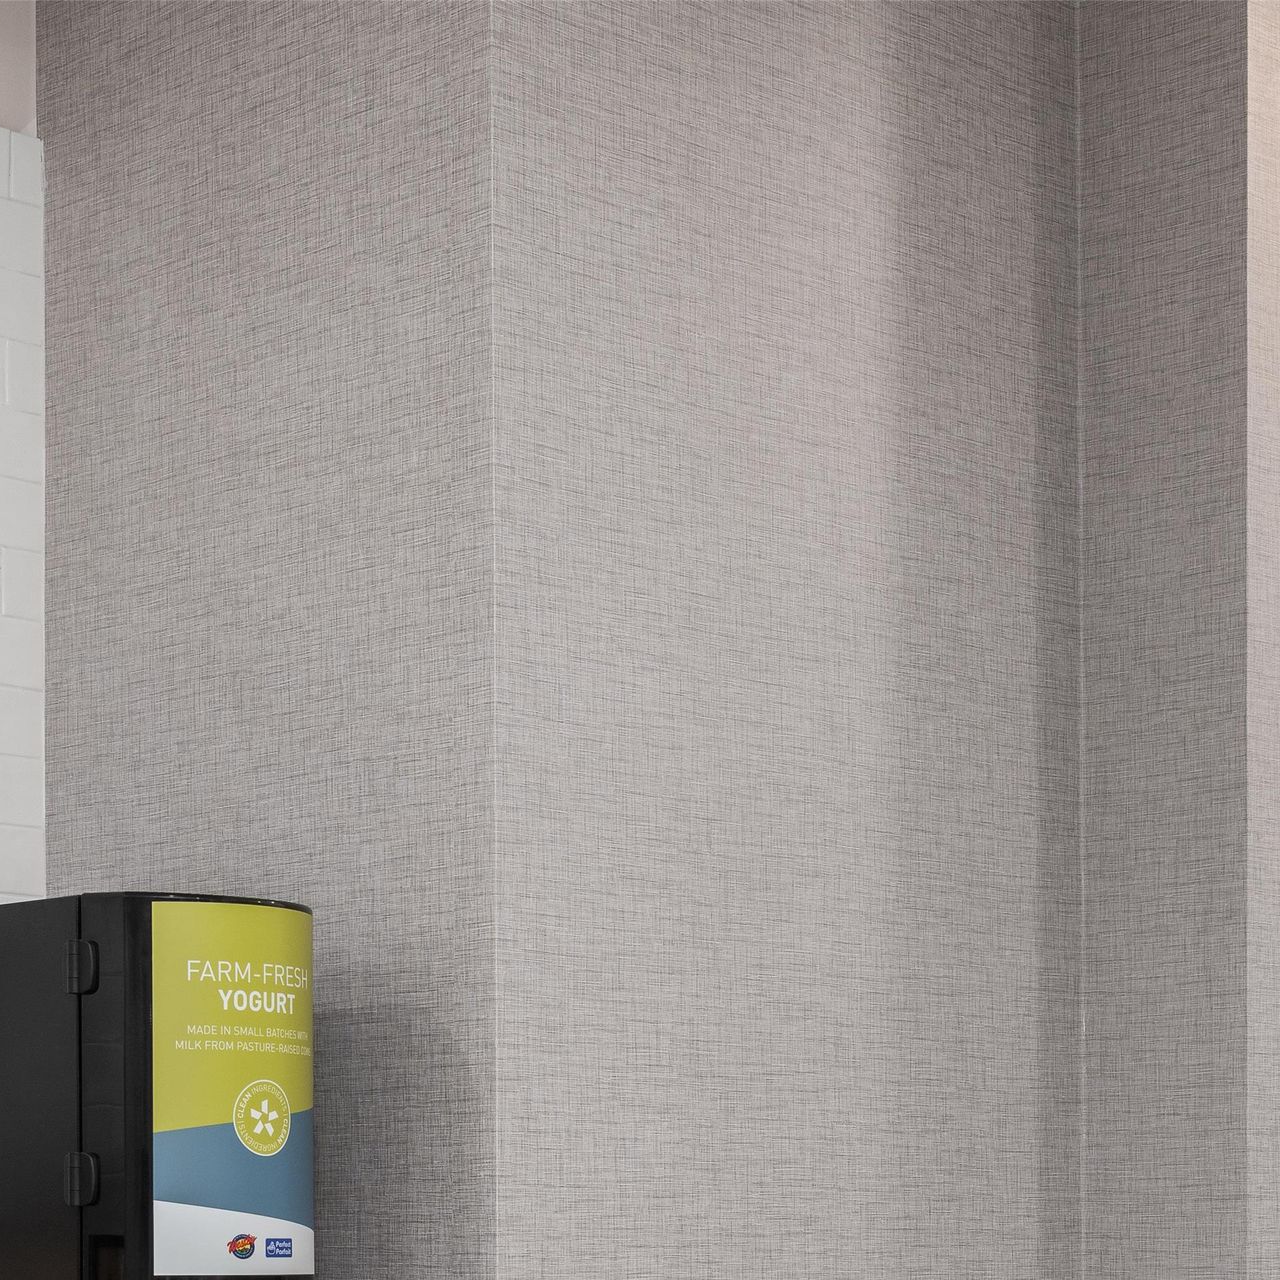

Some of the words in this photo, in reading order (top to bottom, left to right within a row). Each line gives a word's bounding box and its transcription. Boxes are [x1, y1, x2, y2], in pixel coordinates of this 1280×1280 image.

[187, 960, 308, 989] FARM-FRESH
[218, 989, 295, 1015] YOGURT
[187, 1025, 218, 1035] MADE
[220, 1026, 231, 1036] IN
[233, 1026, 264, 1037] SMALL
[266, 1028, 297, 1039] BATCHES
[175, 1040, 202, 1050] MILK
[205, 1040, 234, 1051] FROM
[236, 1042, 300, 1055] PASTURE-RAISED
[237, 1092, 253, 1119] CLEAN
[277, 1118, 289, 1145] CLEAN
